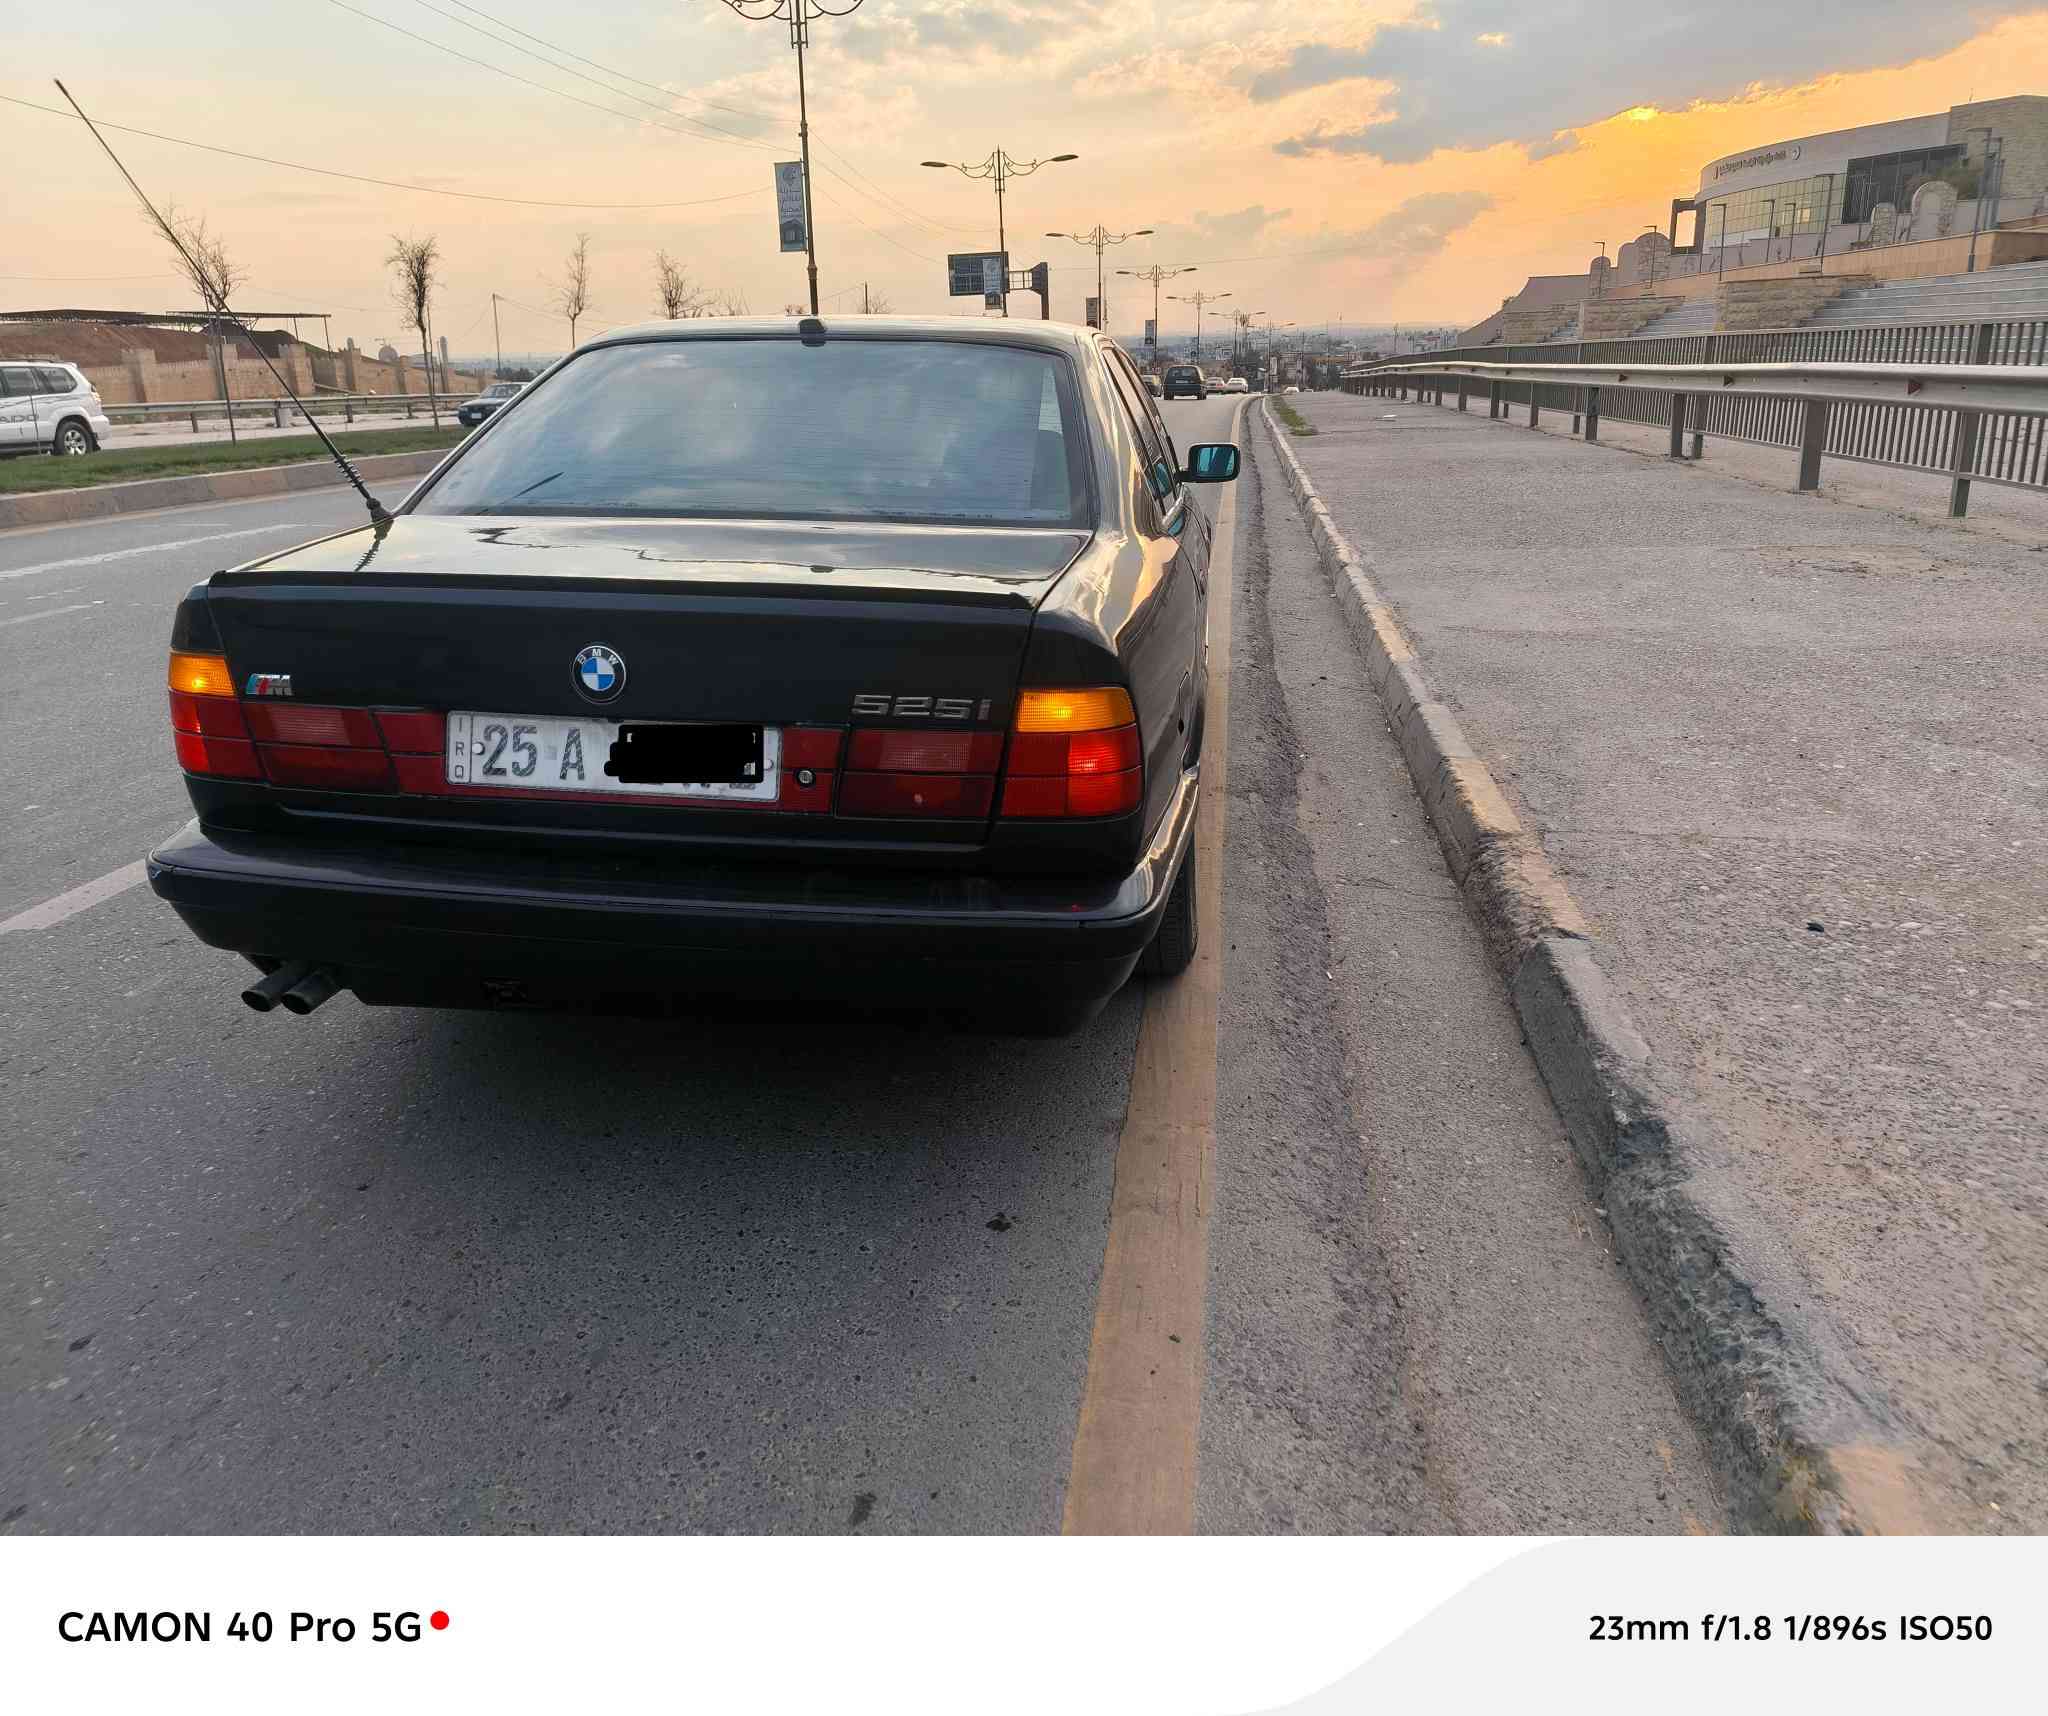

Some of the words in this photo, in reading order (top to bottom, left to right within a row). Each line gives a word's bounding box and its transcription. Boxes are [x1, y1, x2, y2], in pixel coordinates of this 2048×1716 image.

[575, 648, 619, 665] BMW
[483, 724, 537, 777] 25
[559, 727, 585, 780] A
